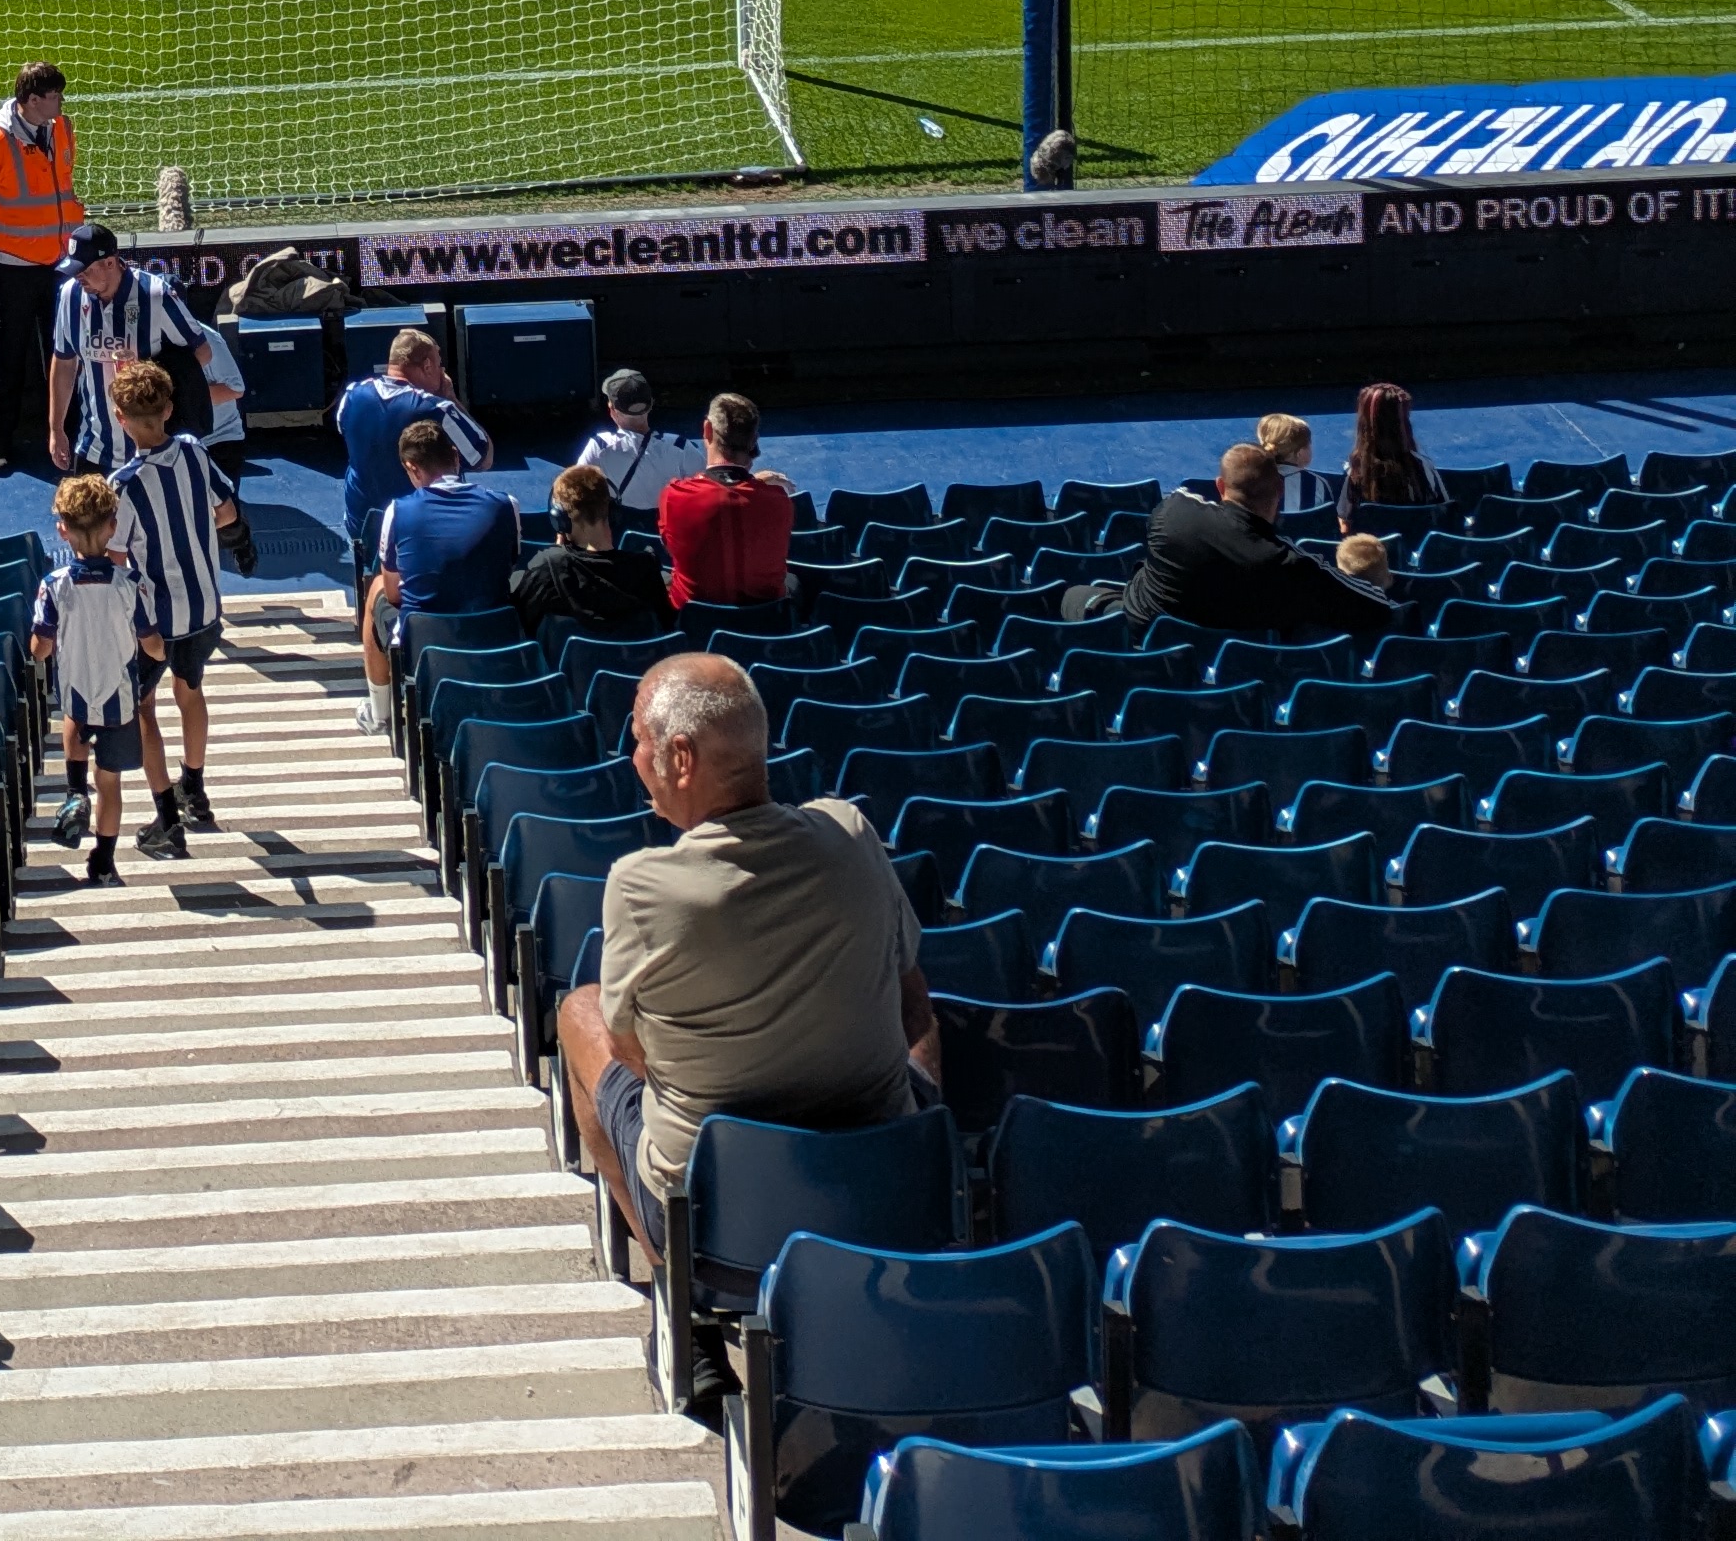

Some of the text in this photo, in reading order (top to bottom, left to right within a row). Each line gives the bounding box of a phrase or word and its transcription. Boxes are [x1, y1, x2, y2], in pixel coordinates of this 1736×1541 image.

[377, 219, 912, 279] www.wecleanltd.com
[940, 221, 1007, 254] we
[1014, 213, 1145, 249] clean
[1379, 201, 1464, 236] AND
[1476, 195, 1613, 232] PROUD
[1626, 191, 1680, 224] OF
[85, 329, 132, 351] ideal
